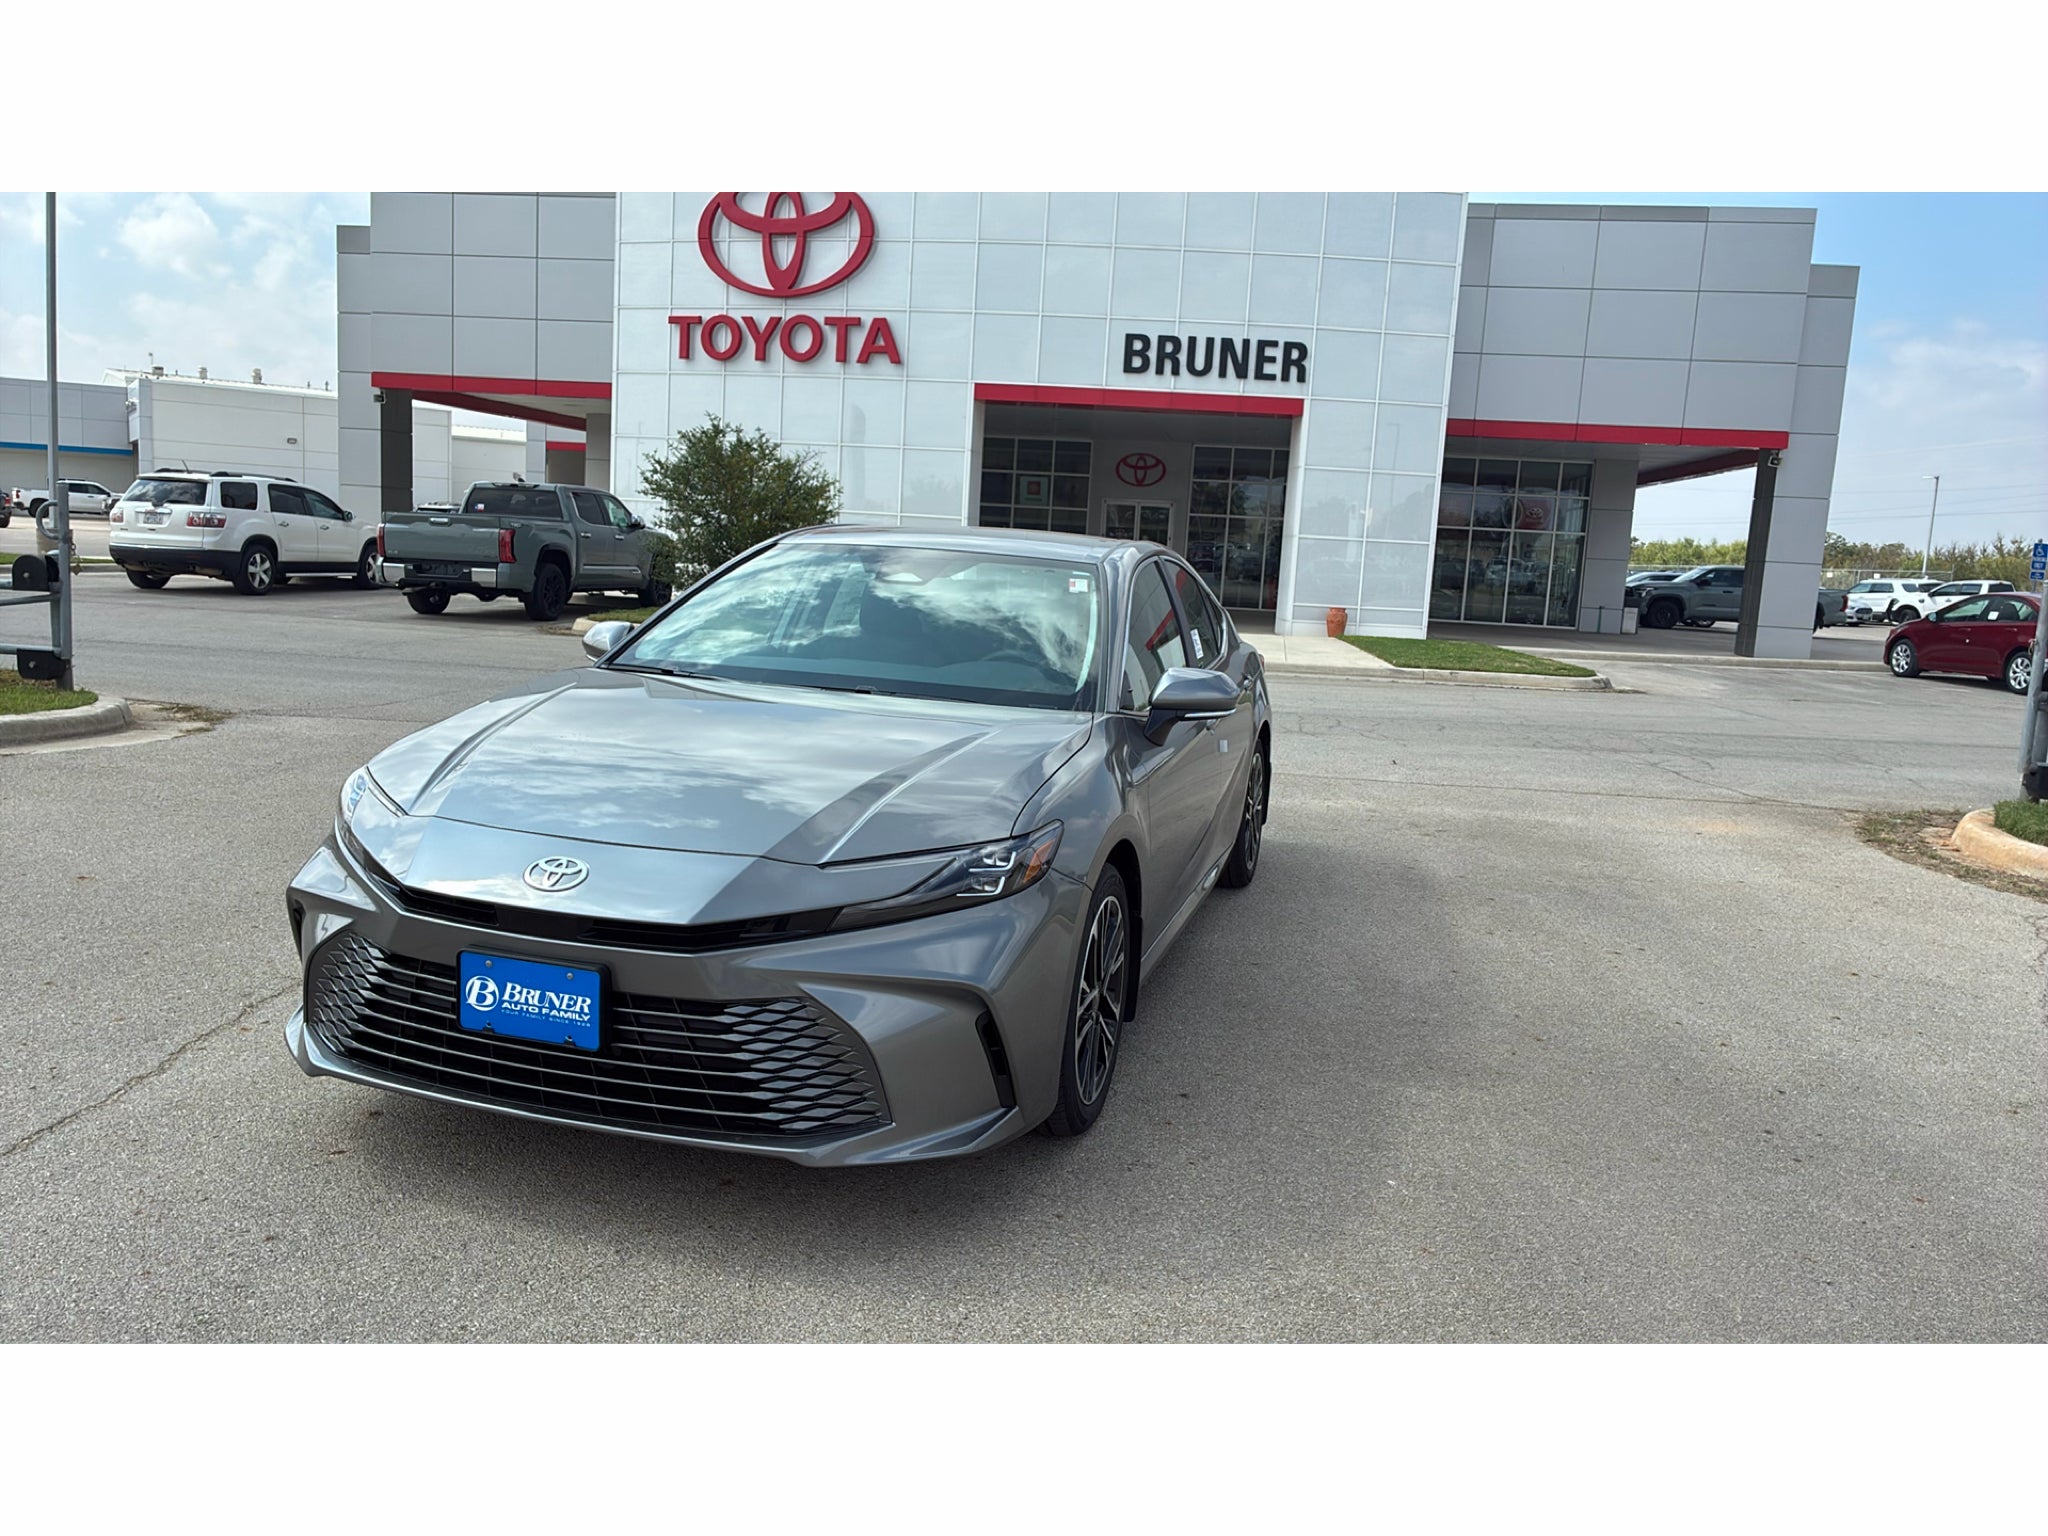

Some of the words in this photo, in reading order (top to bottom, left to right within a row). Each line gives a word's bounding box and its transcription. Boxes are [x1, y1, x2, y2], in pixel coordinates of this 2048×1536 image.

[668, 314, 902, 364] TOYOTA
[1123, 333, 1308, 383] BRUNER
[502, 982, 592, 1014] BRUNER
[502, 1002, 539, 1013] AUTO
[542, 1008, 591, 1022] FAMILY
[522, 1012, 546, 1020] FAMILY
